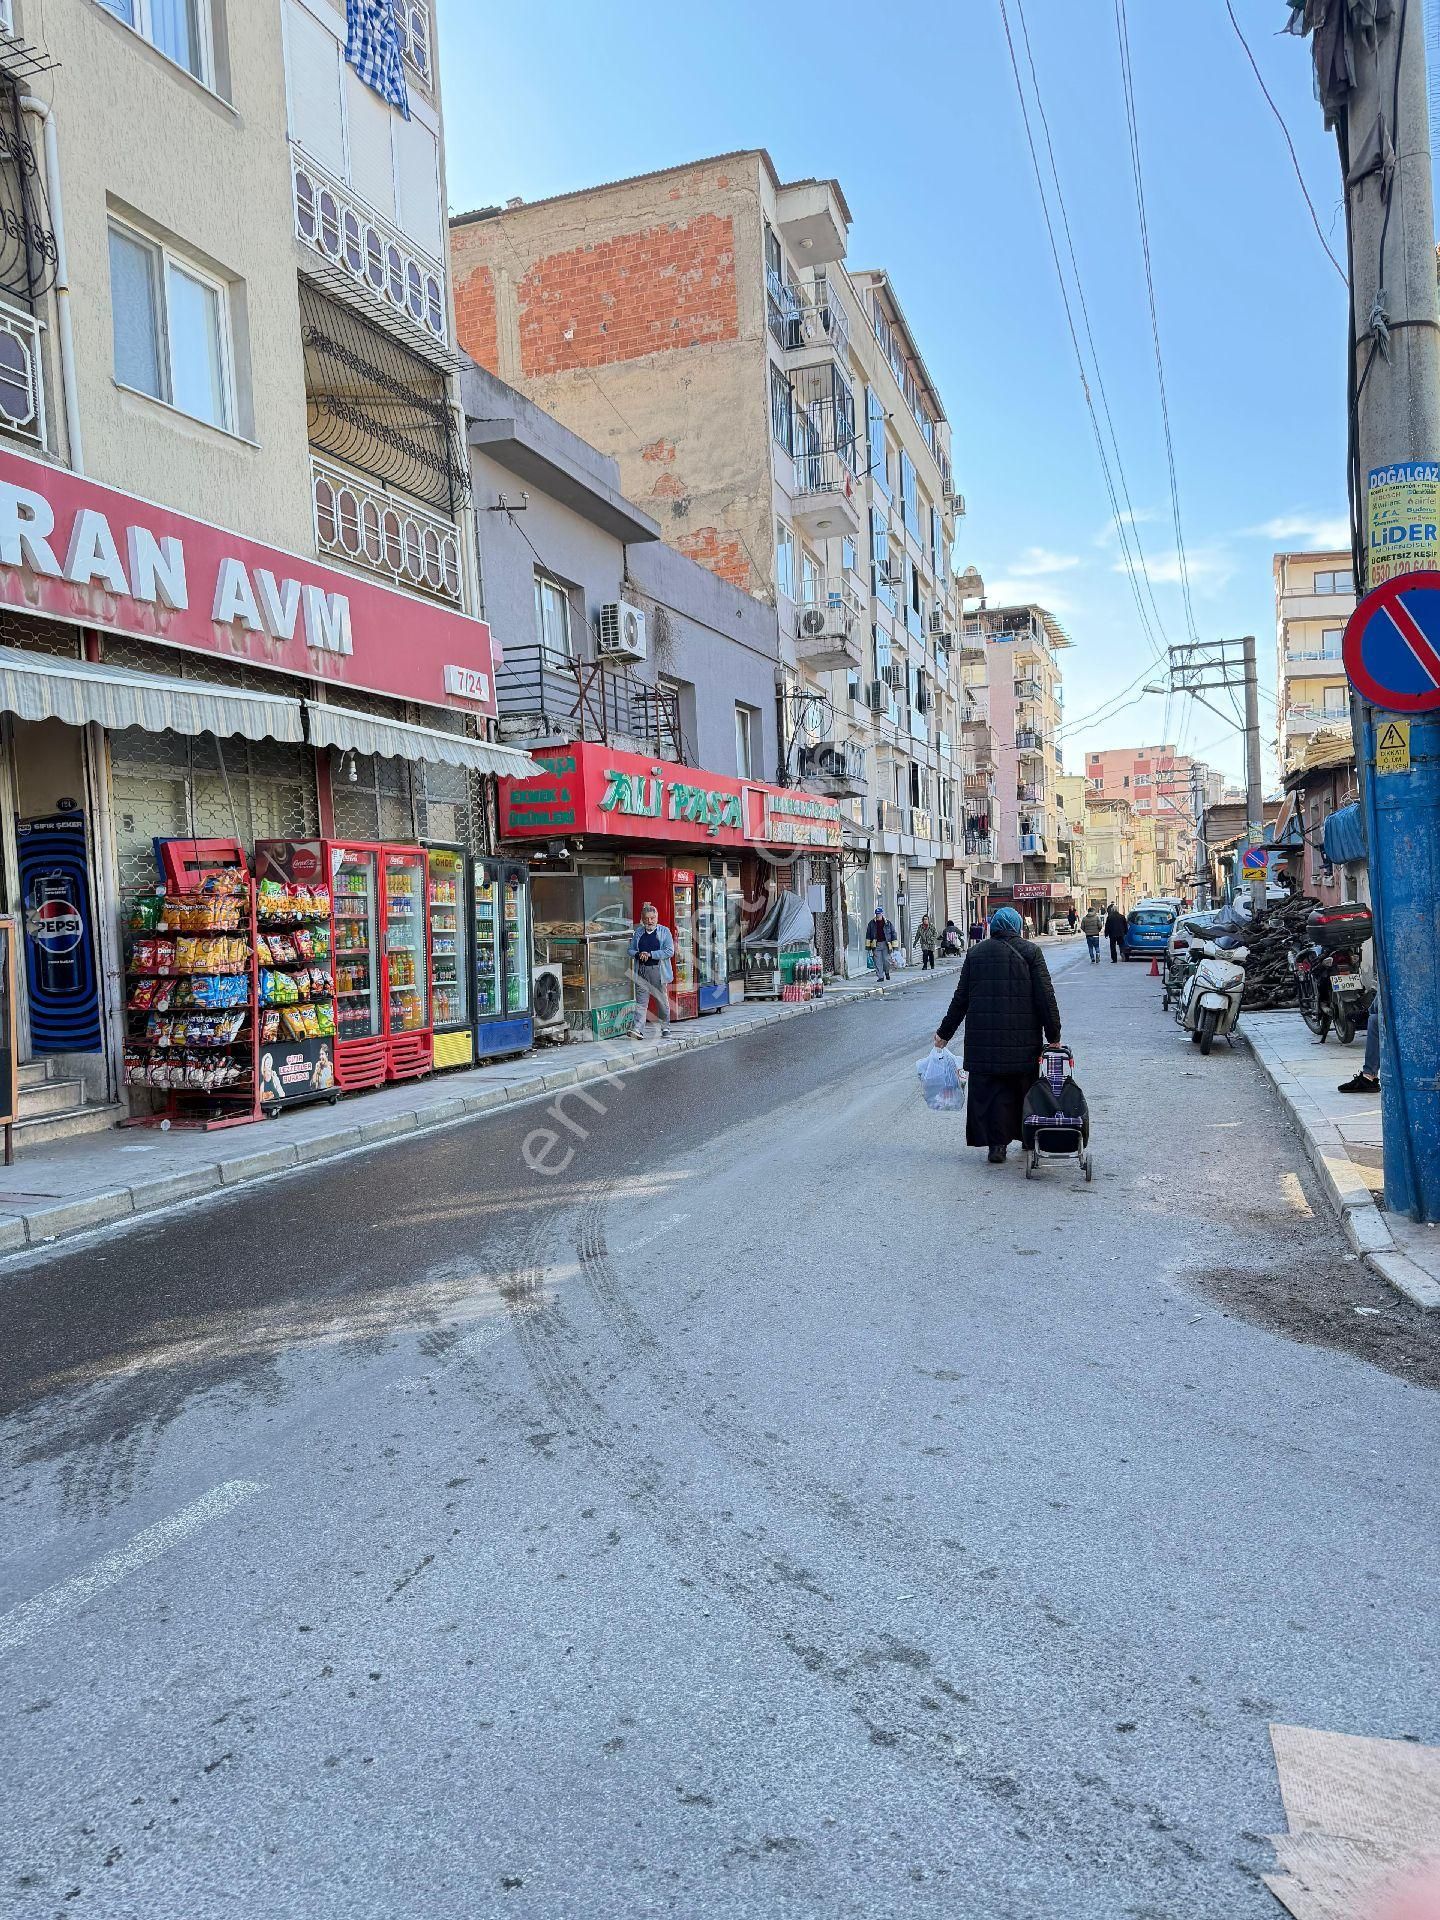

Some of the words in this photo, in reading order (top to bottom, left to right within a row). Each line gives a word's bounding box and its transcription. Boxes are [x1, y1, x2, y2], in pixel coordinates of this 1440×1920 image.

[1370, 466, 1439, 490] DOĞALGAZ
[1415, 496, 1437, 505] airfel
[1371, 551, 1412, 565] ÜCRETSİZ
[1413, 549, 1438, 559] KEŞİF
[211, 557, 354, 656] AVM
[457, 671, 483, 696] 7/24
[510, 788, 558, 805] EKMEK
[597, 766, 664, 819] ALİ
[666, 782, 743, 837] PAŞA
[55, 821, 83, 830] ŞEKER
[508, 807, 576, 828] ÜRÜNLERİ
